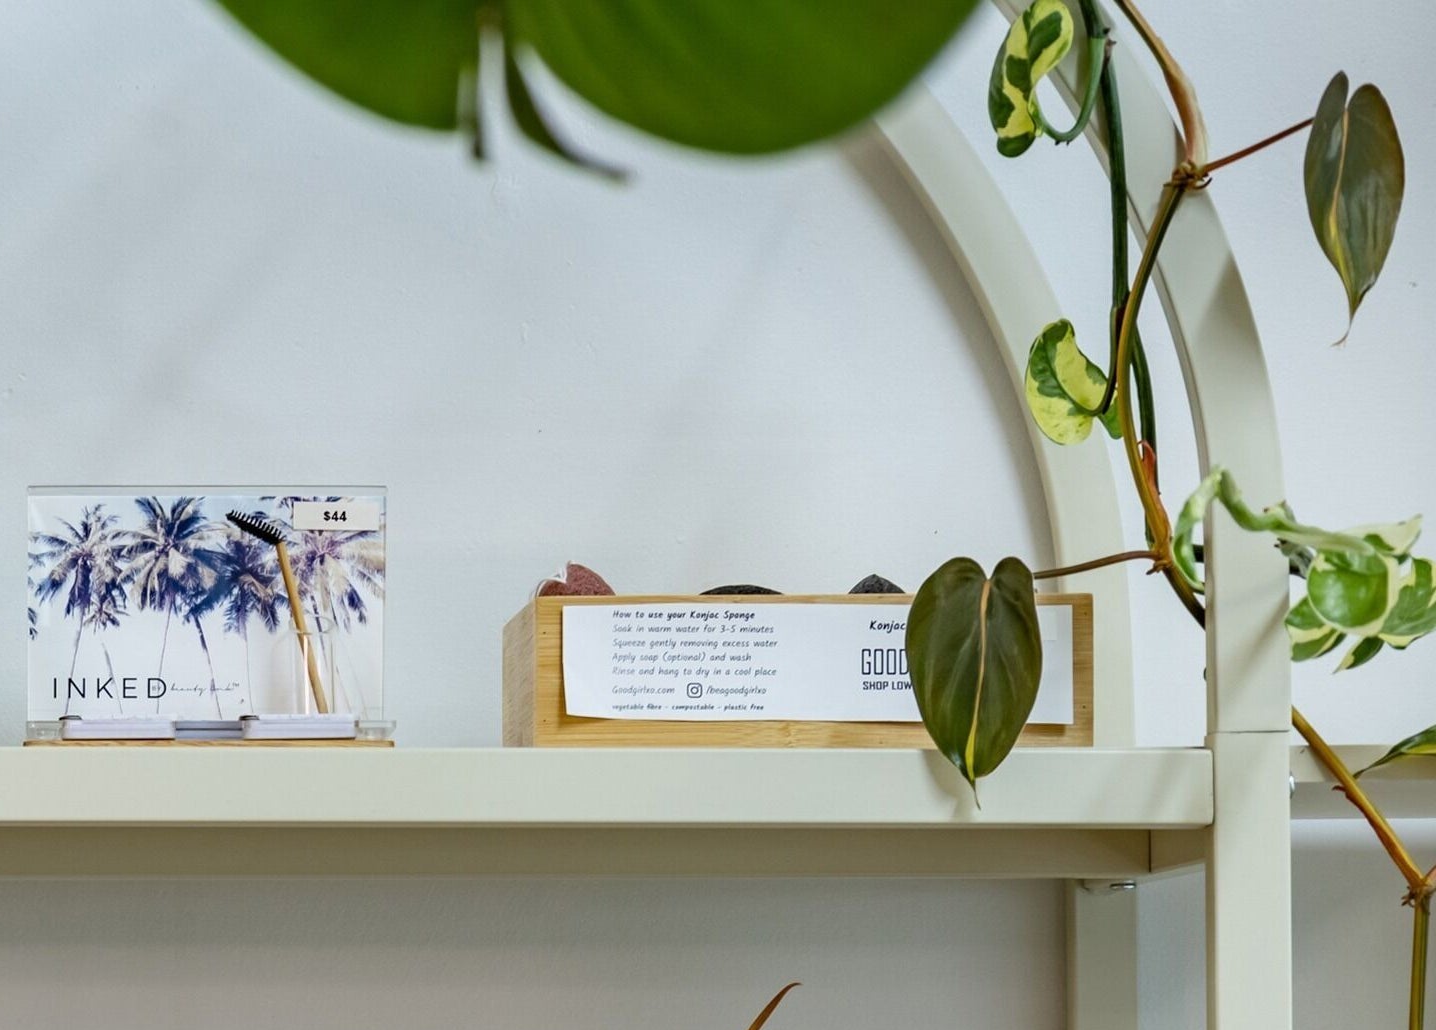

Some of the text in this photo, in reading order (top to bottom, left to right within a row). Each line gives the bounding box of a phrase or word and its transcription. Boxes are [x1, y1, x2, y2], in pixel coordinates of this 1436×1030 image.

[323, 511, 346, 522] $44
[667, 613, 686, 621] your
[690, 611, 719, 622] Konjac
[723, 610, 755, 622] Sponge
[612, 624, 632, 632] Soak
[704, 624, 716, 633] for
[720, 625, 736, 633] 3-5
[740, 625, 774, 633] minutes
[869, 620, 906, 634] Konjac
[53, 677, 167, 699] INKED
[863, 681, 889, 690] SHOP
